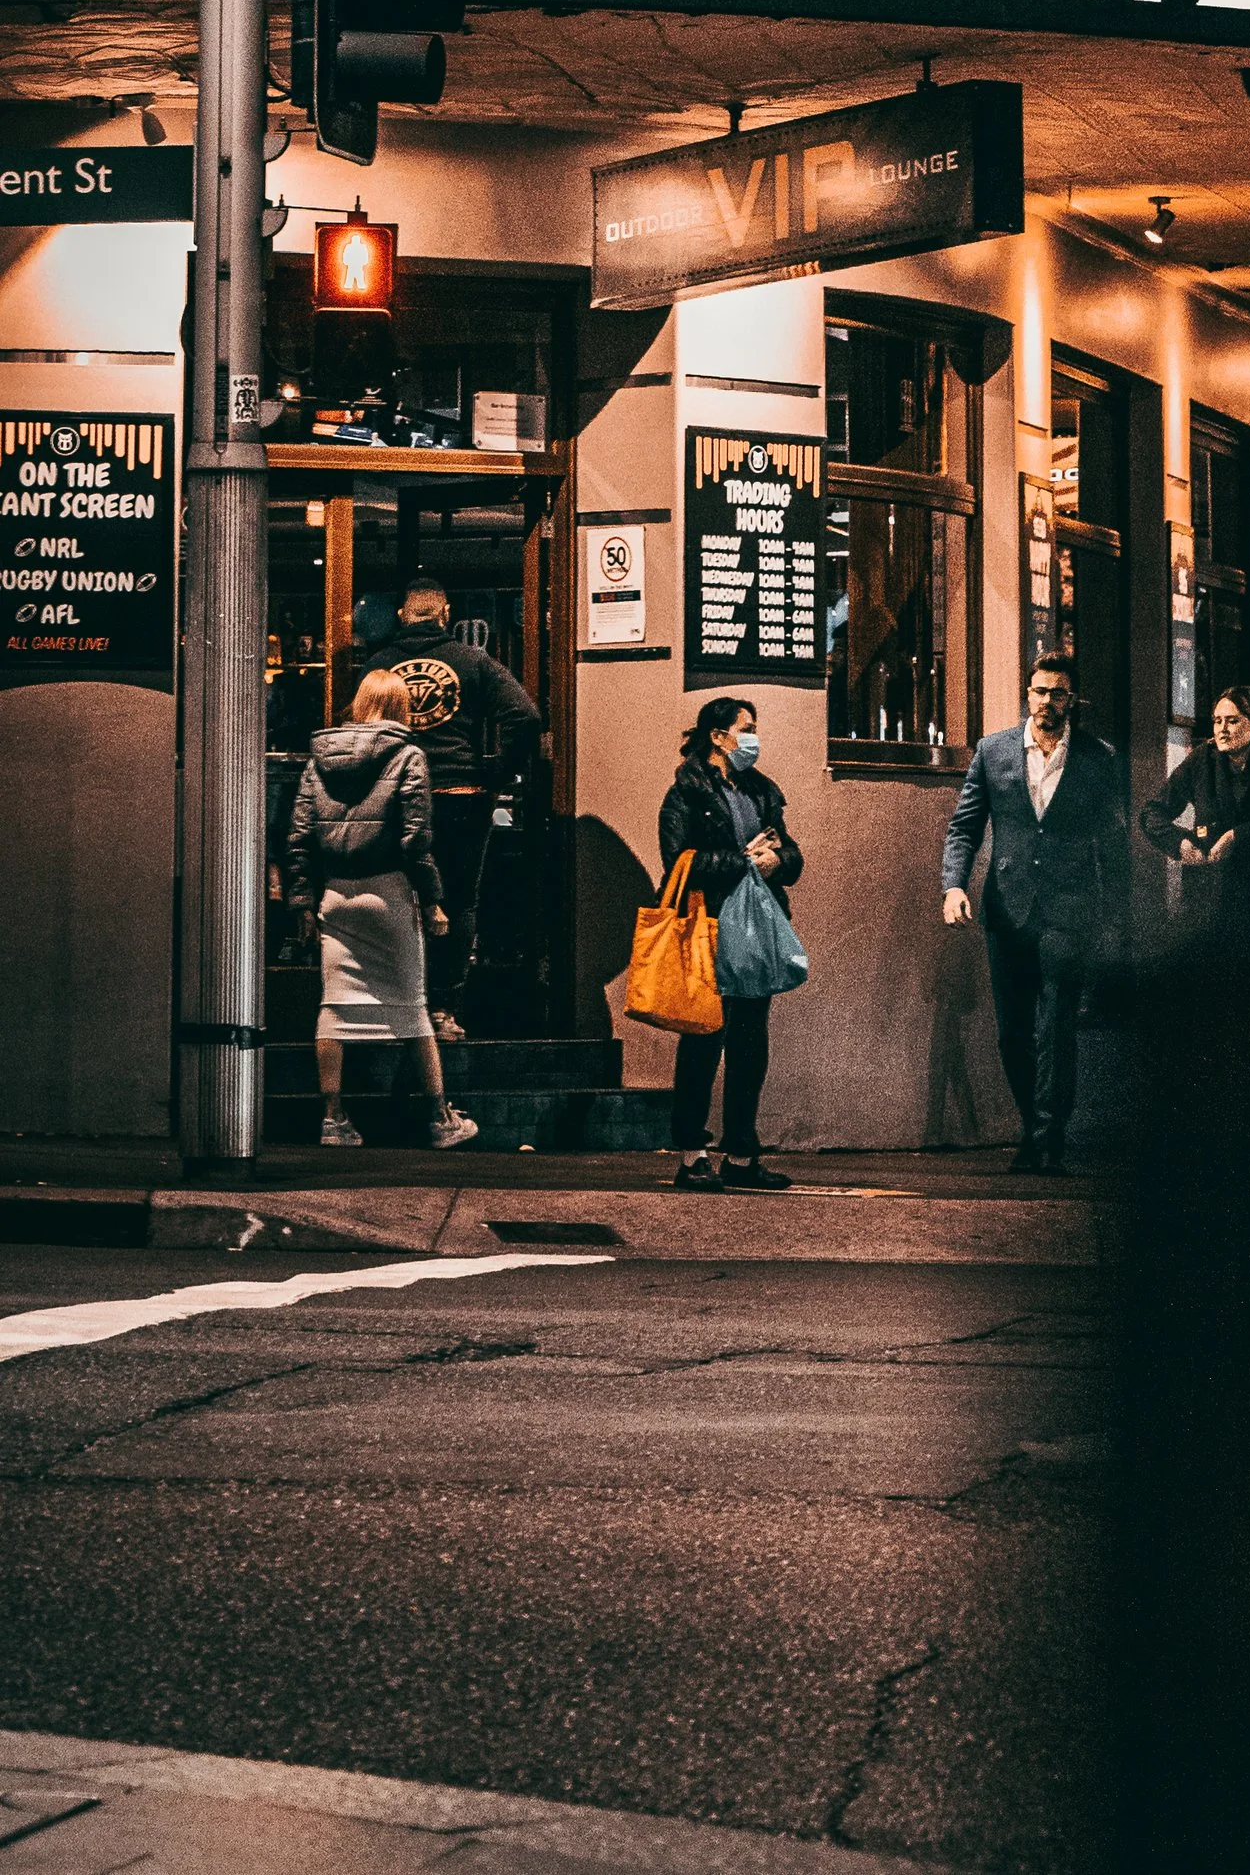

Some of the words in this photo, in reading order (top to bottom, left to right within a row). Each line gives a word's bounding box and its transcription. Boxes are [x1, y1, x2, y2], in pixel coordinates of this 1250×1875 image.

[75, 157, 113, 193] St
[605, 205, 706, 243] OUTDOOR
[707, 141, 856, 247] VIP
[868, 150, 959, 186] LOUNGE
[19, 461, 58, 487] ON
[62, 462, 111, 488] THE
[723, 479, 792, 508] TRADING
[59, 492, 155, 519] SCREEN
[736, 507, 785, 534] HOURS
[40, 537, 84, 558] NRL
[701, 534, 742, 551] MONDAY
[758, 538, 785, 554] 10AM
[607, 546, 626, 566] 50
[700, 552, 740, 568] TUESDAY
[758, 556, 785, 571] 10AM
[0, 569, 57, 592] UGBY
[61, 571, 134, 592] UNION
[701, 569, 754, 587] WEDNESDAY
[758, 573, 785, 588] 10AM
[701, 586, 746, 604] THURSDAY
[758, 590, 785, 605] 10AM
[40, 604, 80, 625] AFL
[701, 604, 735, 620] FRIDAY
[758, 608, 785, 622] 10AM
[701, 621, 747, 638] SATURDAY
[758, 625, 785, 640] 10AM
[7, 636, 28, 650] ALL
[31, 636, 76, 651] GAMES
[701, 639, 739, 655] SUNDAY
[758, 642, 785, 657] 10AM
